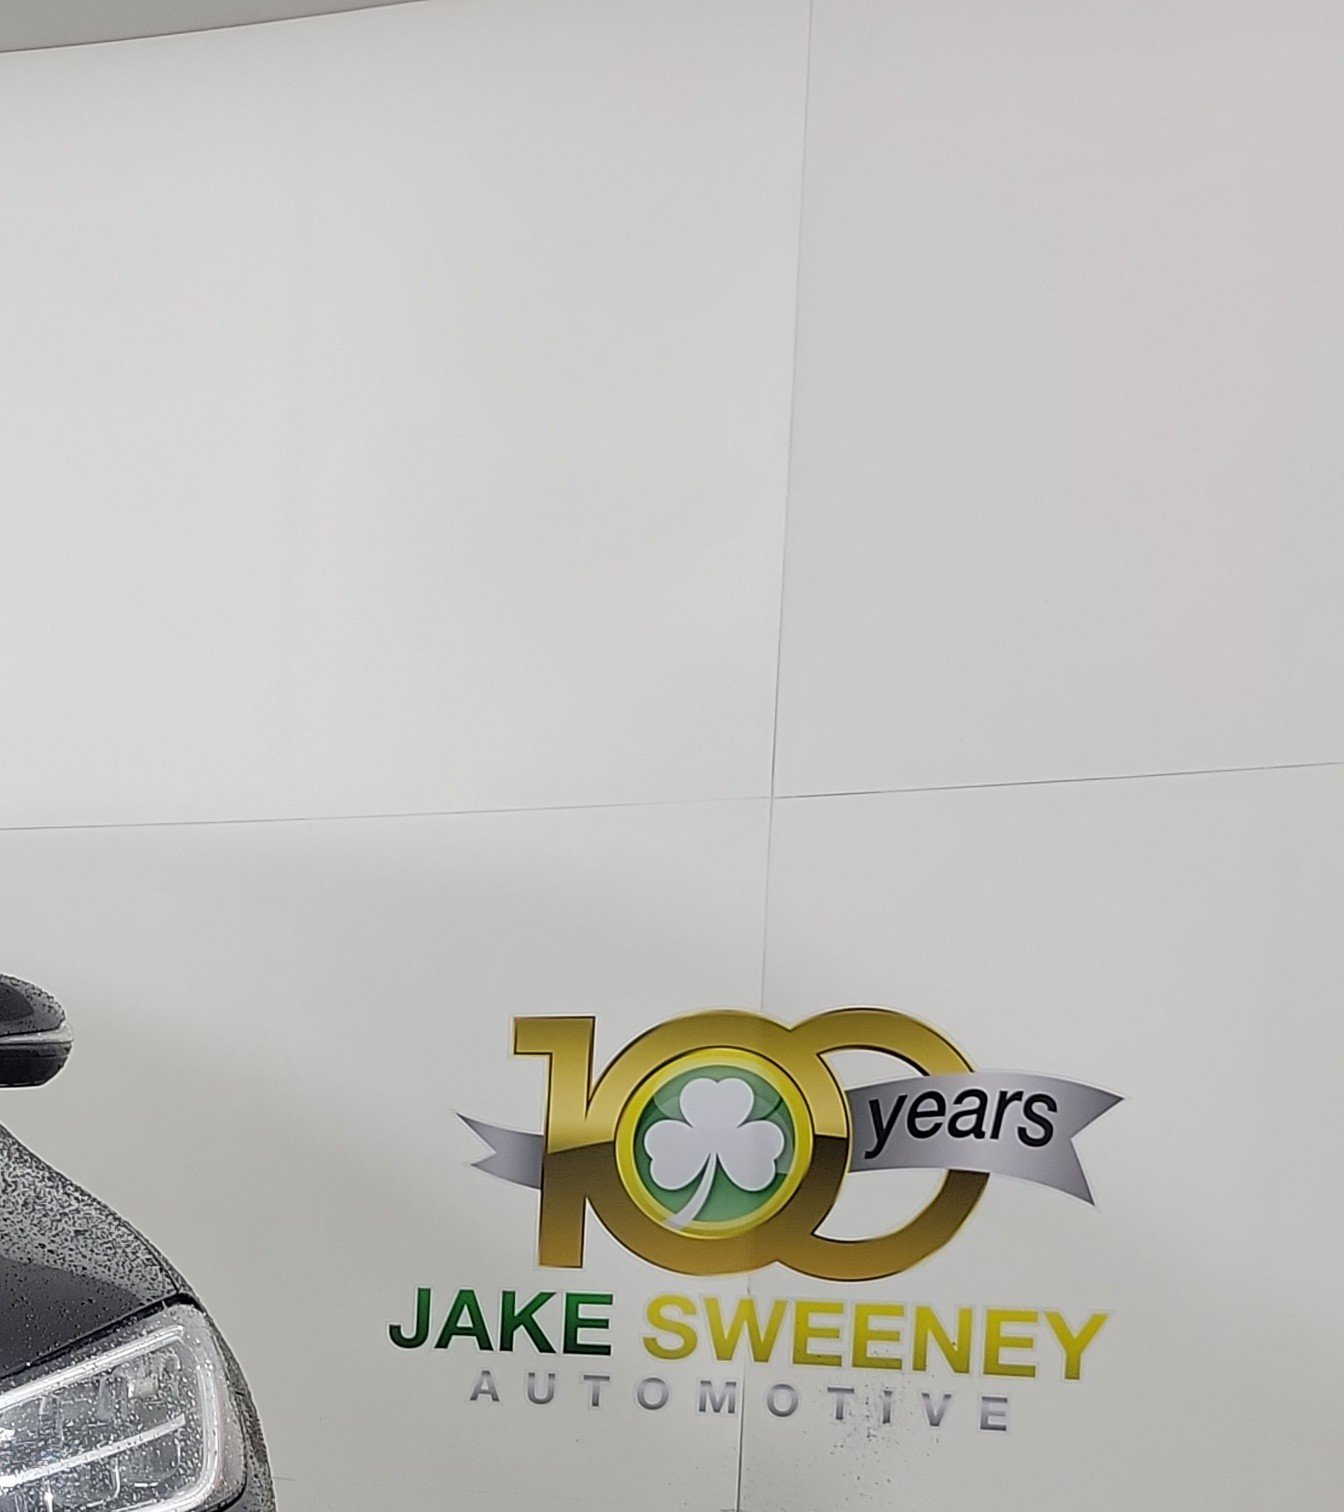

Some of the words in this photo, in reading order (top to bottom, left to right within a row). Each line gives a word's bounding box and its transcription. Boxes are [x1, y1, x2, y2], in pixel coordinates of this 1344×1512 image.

[514, 1007, 990, 1282] 100
[865, 1087, 1058, 1158] years
[388, 1287, 613, 1356] JAKE
[643, 1294, 1108, 1380] SWEENEY
[469, 1369, 1009, 1432] AUTOMOTIVE
